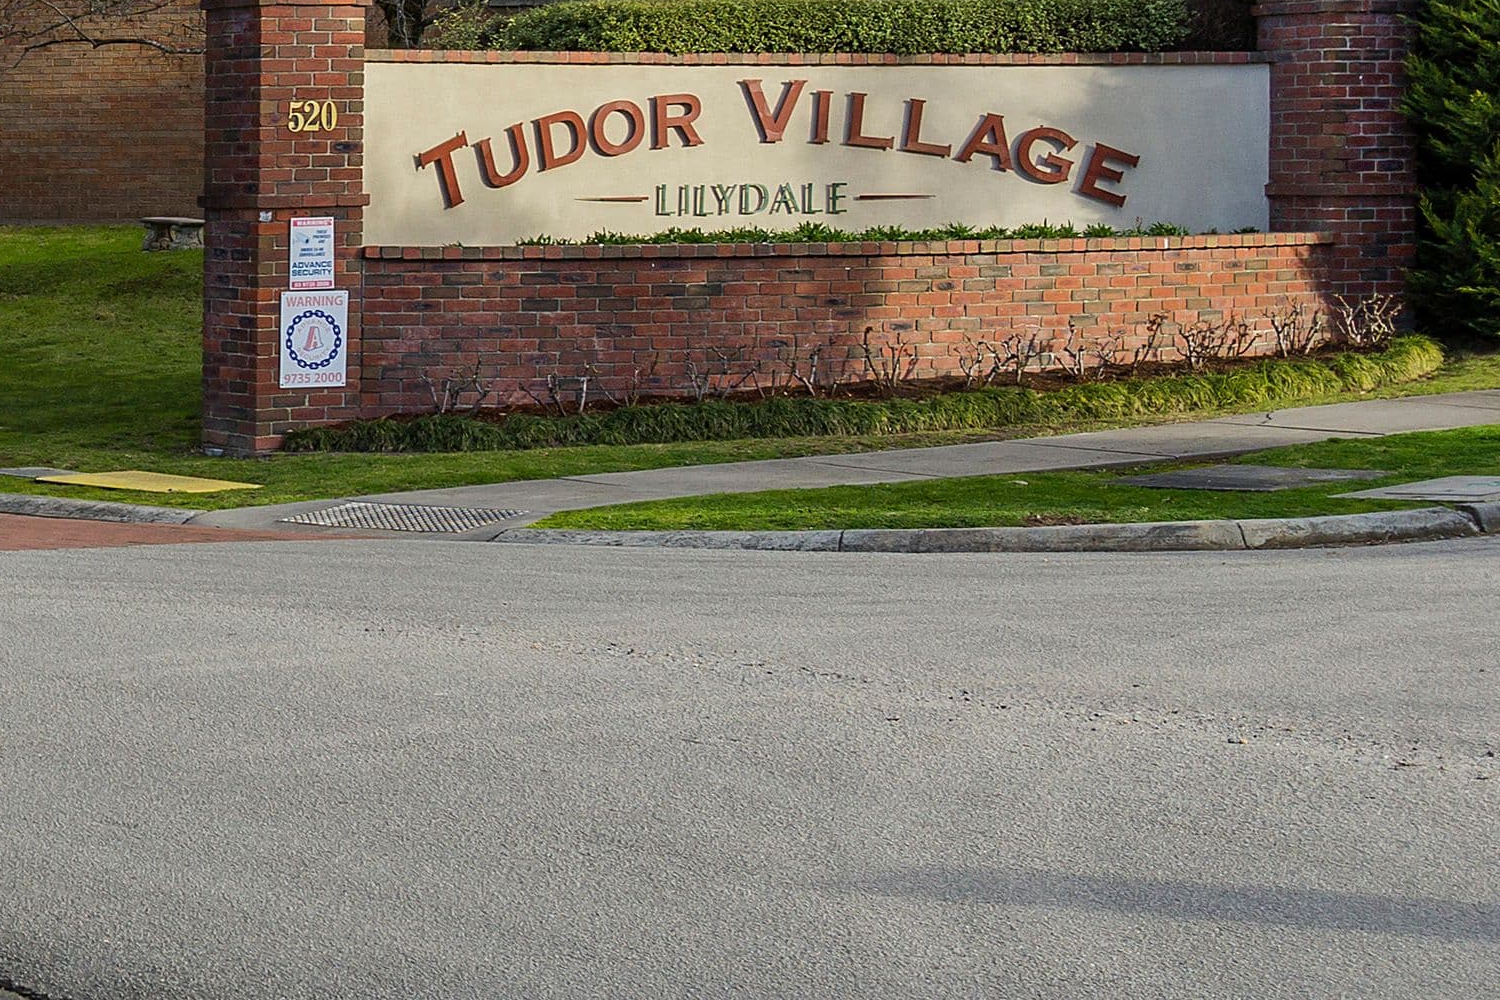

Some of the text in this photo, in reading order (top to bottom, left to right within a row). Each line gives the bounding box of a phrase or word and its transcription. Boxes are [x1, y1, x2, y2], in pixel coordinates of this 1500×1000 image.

[287, 100, 338, 132] 520
[412, 79, 1140, 210] TUDOR VILLAGE
[655, 183, 847, 217] LILYDALE
[292, 261, 332, 269] ADVANCE
[292, 269, 332, 277] SECURITY
[286, 296, 343, 307] WARNING
[284, 372, 342, 384] 9735 2000
